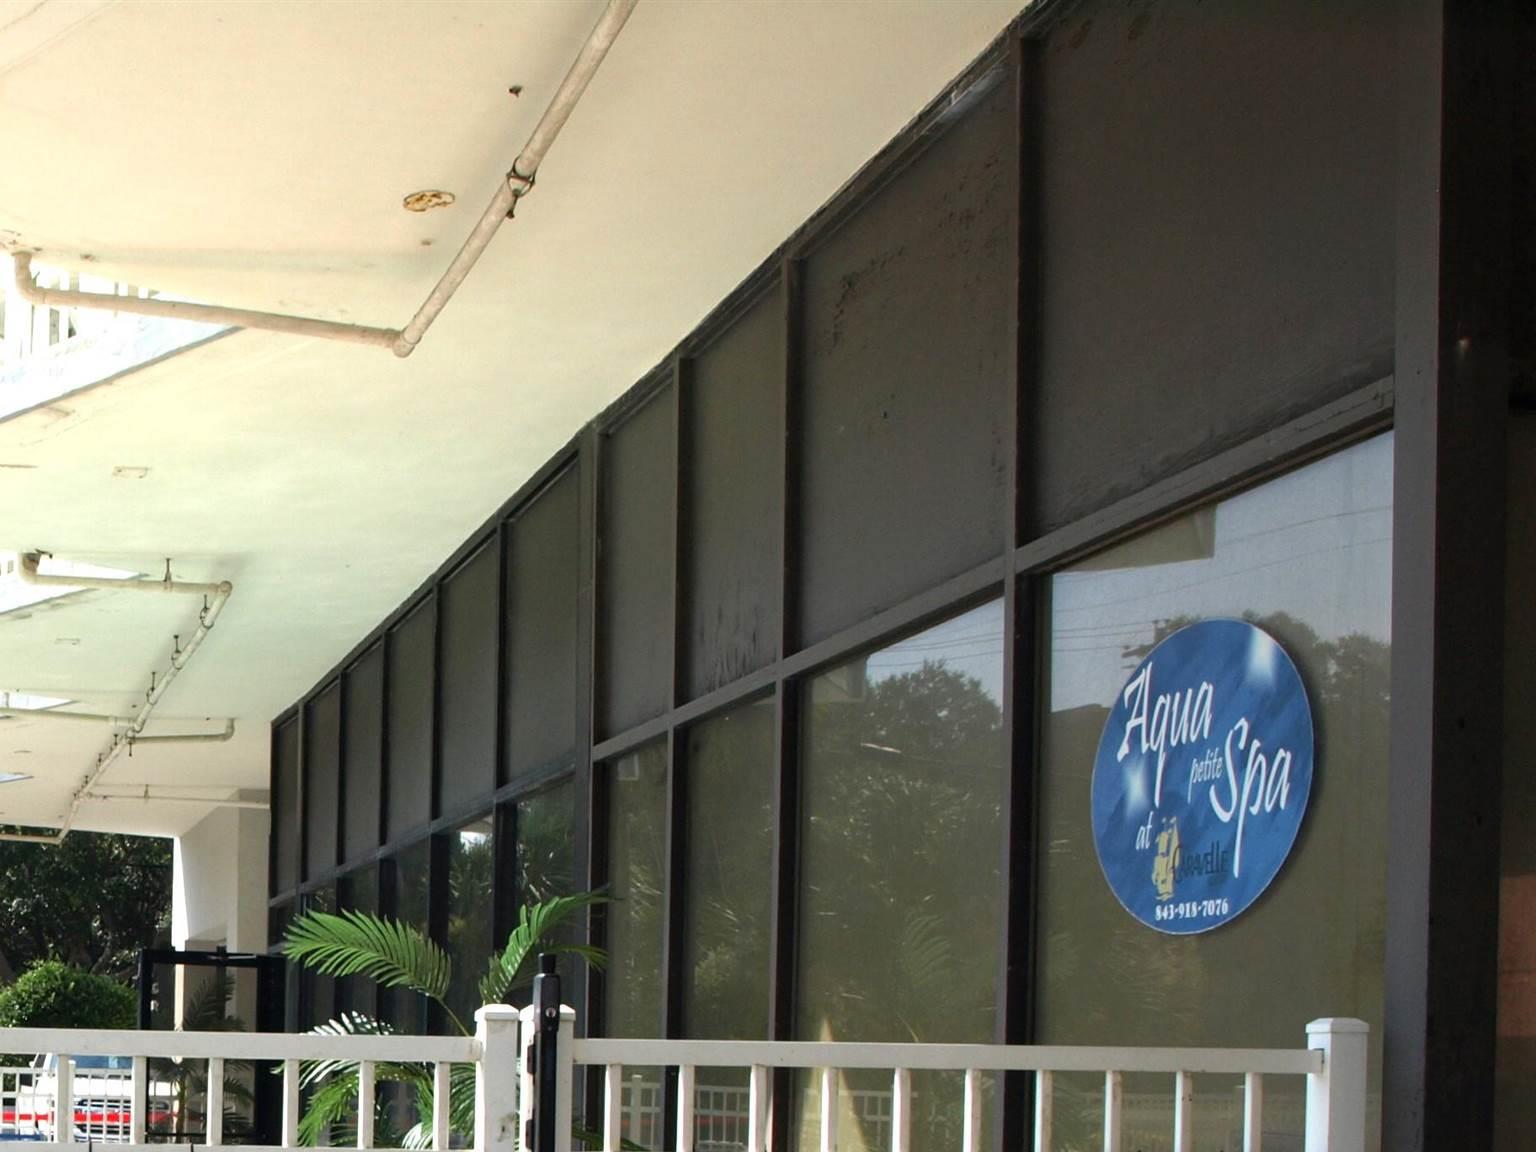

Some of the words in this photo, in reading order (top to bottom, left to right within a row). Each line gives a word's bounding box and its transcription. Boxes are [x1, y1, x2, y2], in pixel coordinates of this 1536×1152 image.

[1117, 661, 1214, 808] Aqua
[1188, 747, 1224, 805] petite
[1209, 717, 1292, 879] Spa
[1135, 810, 1154, 850] at
